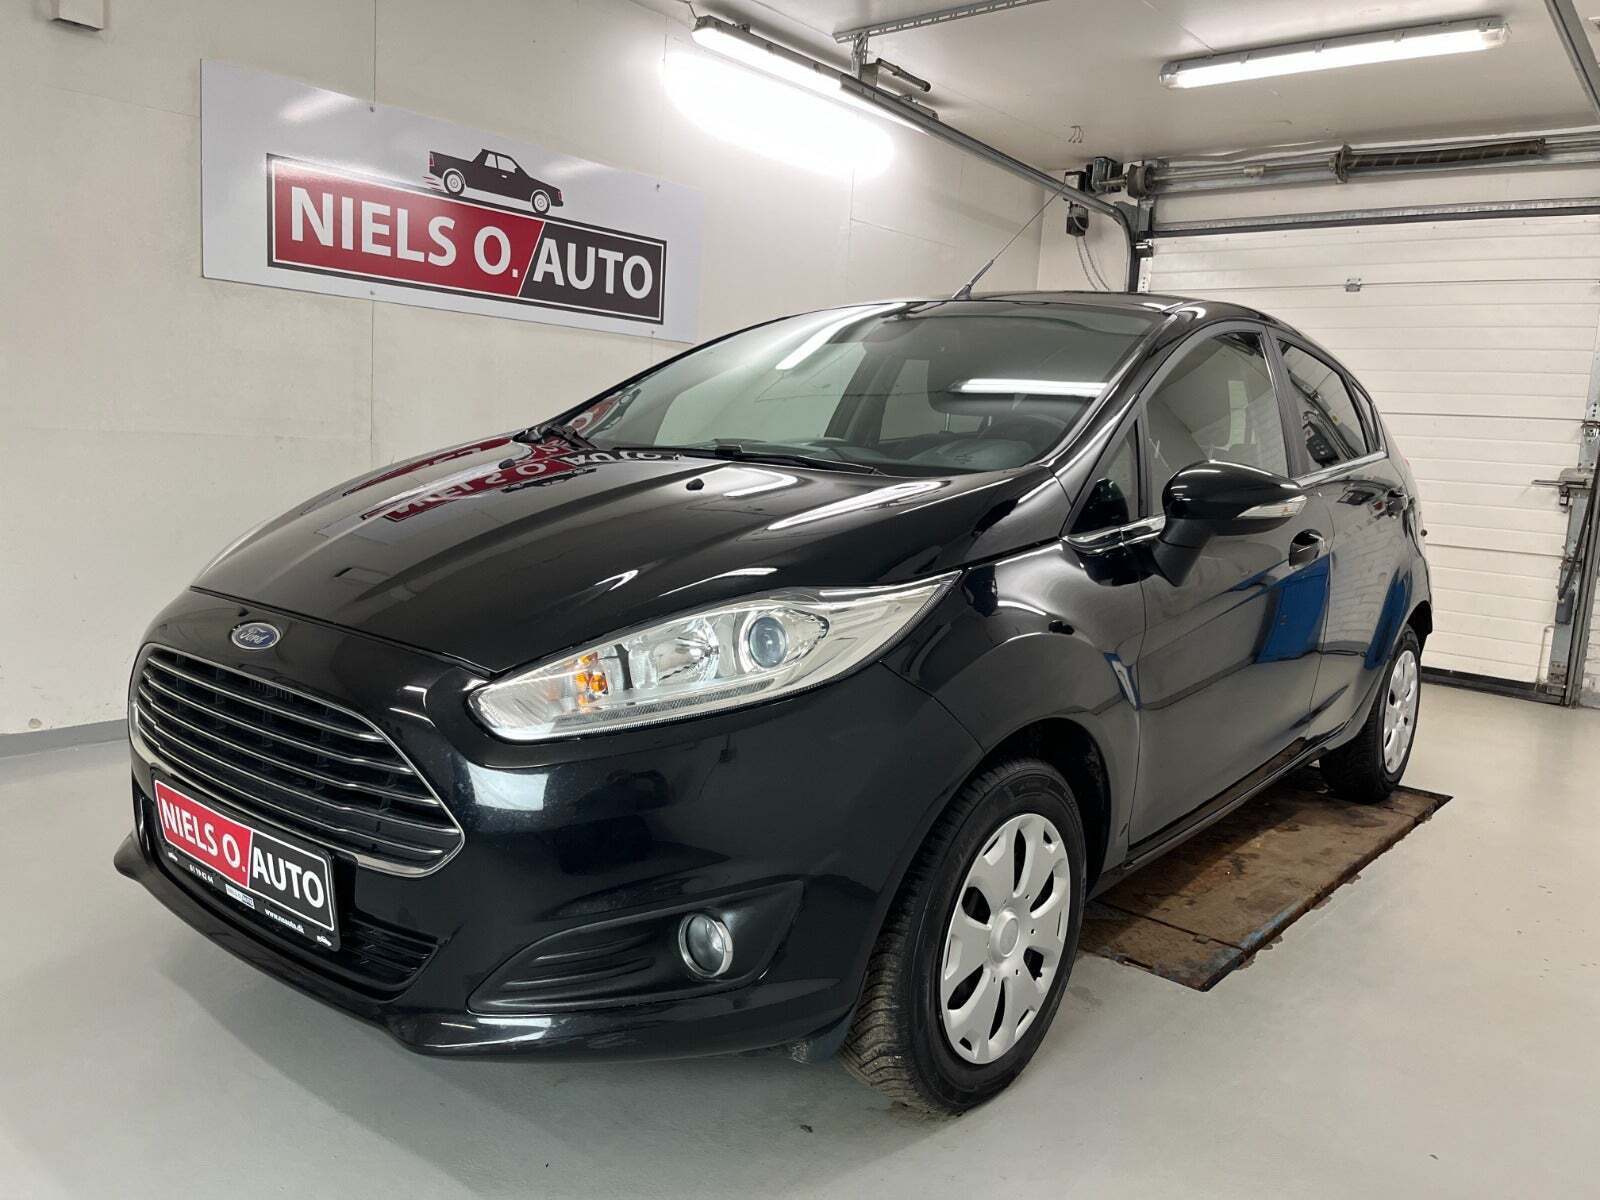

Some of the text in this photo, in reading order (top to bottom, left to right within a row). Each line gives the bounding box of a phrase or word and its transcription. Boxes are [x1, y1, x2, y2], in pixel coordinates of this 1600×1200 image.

[291, 187, 653, 300] NIELS O. AUTO
[160, 798, 218, 857] NIELS
[222, 833, 246, 873] O.
[252, 846, 325, 909] AUTO
